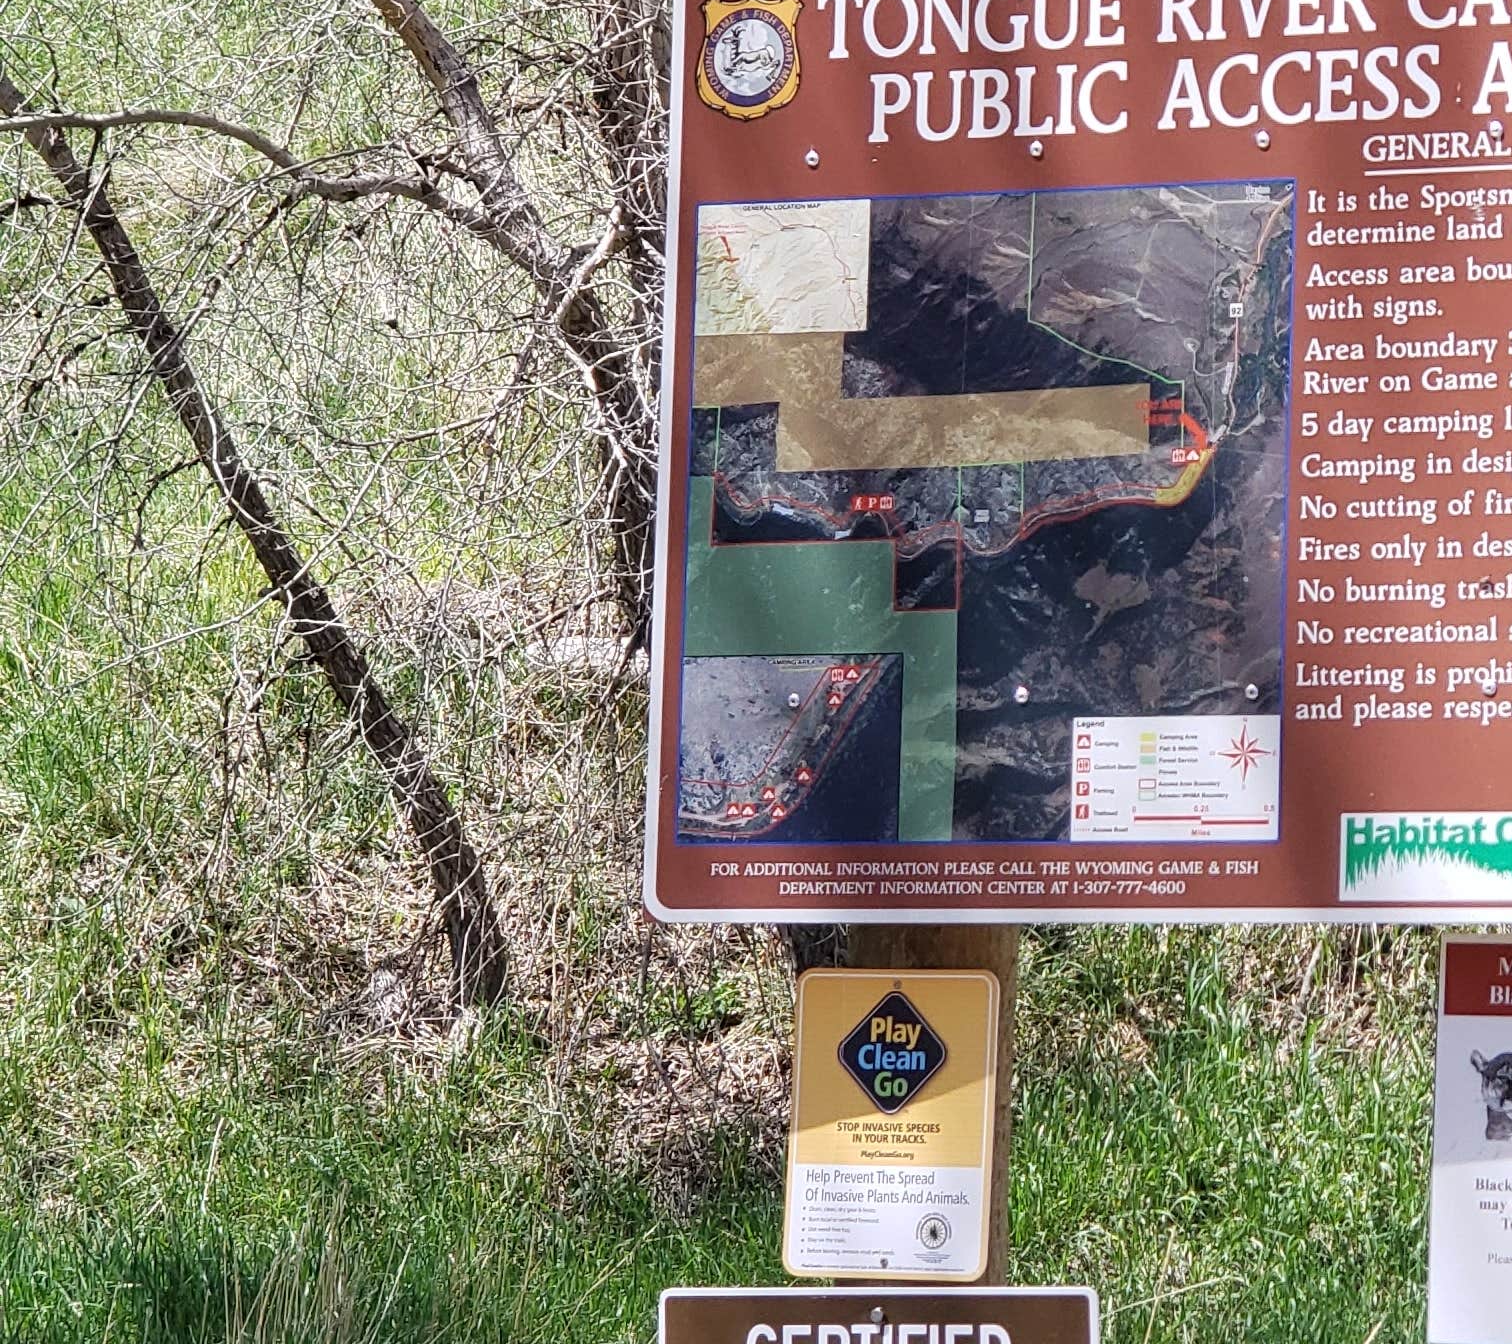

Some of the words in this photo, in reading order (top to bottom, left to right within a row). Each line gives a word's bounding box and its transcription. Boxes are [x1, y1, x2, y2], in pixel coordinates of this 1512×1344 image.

[869, 61, 1127, 142] PUBLIC
[1157, 44, 1442, 130] ACCESS
[1362, 131, 1511, 162] GENERAL
[1307, 190, 1326, 212] It
[1337, 191, 1357, 211] is
[1369, 185, 1409, 210] the
[1307, 220, 1435, 246] determine
[1447, 214, 1502, 241] land
[1306, 263, 1388, 287] Access
[1400, 265, 1455, 284] area
[1231, 307, 1242, 315] 92
[1306, 294, 1363, 320] with
[1373, 295, 1443, 324] signs.
[1304, 337, 1364, 361] Area
[1376, 332, 1497, 363] boundary
[1303, 371, 1368, 395] River
[1379, 375, 1411, 393] on
[1421, 367, 1497, 391] Game
[1301, 412, 1319, 437] 5
[1327, 409, 1374, 441] day
[1384, 409, 1494, 440] camping
[1301, 453, 1415, 484] Camping
[1426, 452, 1453, 475] in
[1300, 495, 1337, 520] No
[1346, 494, 1437, 524] cutting
[1447, 489, 1475, 516] of
[1298, 537, 1360, 561] Fires
[1371, 533, 1427, 566] only
[1436, 536, 1463, 559] in
[1297, 578, 1335, 603] No
[1345, 576, 1446, 609] burning
[1297, 620, 1334, 644] No
[1344, 615, 1498, 644] recreational
[1296, 661, 1405, 693] Littering
[1415, 662, 1437, 685] is
[1295, 694, 1343, 720] and
[1353, 693, 1433, 726] please
[1346, 816, 1487, 845] Habitat
[711, 862, 739, 876] FOR
[744, 862, 832, 876] ADDITIONAL
[837, 862, 939, 876] INFORMATION
[944, 861, 995, 875] PLEASE
[1000, 861, 1036, 875] CALL
[1040, 861, 1070, 875] THE
[1075, 861, 1154, 875] WYOMING
[1158, 861, 1203, 875] GAME
[1208, 861, 1220, 875] &
[1225, 860, 1259, 874] FISH
[779, 881, 876, 895] DEPARTMENT
[880, 881, 983, 895] INFORMATION
[988, 880, 1045, 894] CENTER
[1050, 880, 1069, 894] AT
[1073, 880, 1186, 895] 1-307-777-4600
[870, 1016, 922, 1050] Play
[857, 1042, 926, 1071] Clean
[873, 1071, 908, 1097] Go
[837, 1122, 860, 1132] STOP
[862, 1122, 904, 1133] INVASIVE
[906, 1123, 941, 1134] SPECIES
[852, 1134, 862, 1143] IN
[864, 1134, 889, 1144] YOUR
[891, 1134, 927, 1144] TRACKS.
[806, 1169, 831, 1185] Help
[833, 1169, 875, 1184] Prevent
[877, 1170, 896, 1184] The
[897, 1171, 935, 1187] Spread
[1475, 1177, 1512, 1192] Black
[805, 1187, 819, 1202] Of
[821, 1188, 864, 1202] Invasive
[867, 1189, 899, 1203] Plants
[901, 1190, 924, 1204] And
[925, 1191, 970, 1205] Animals.
[1479, 1200, 1507, 1213] may
